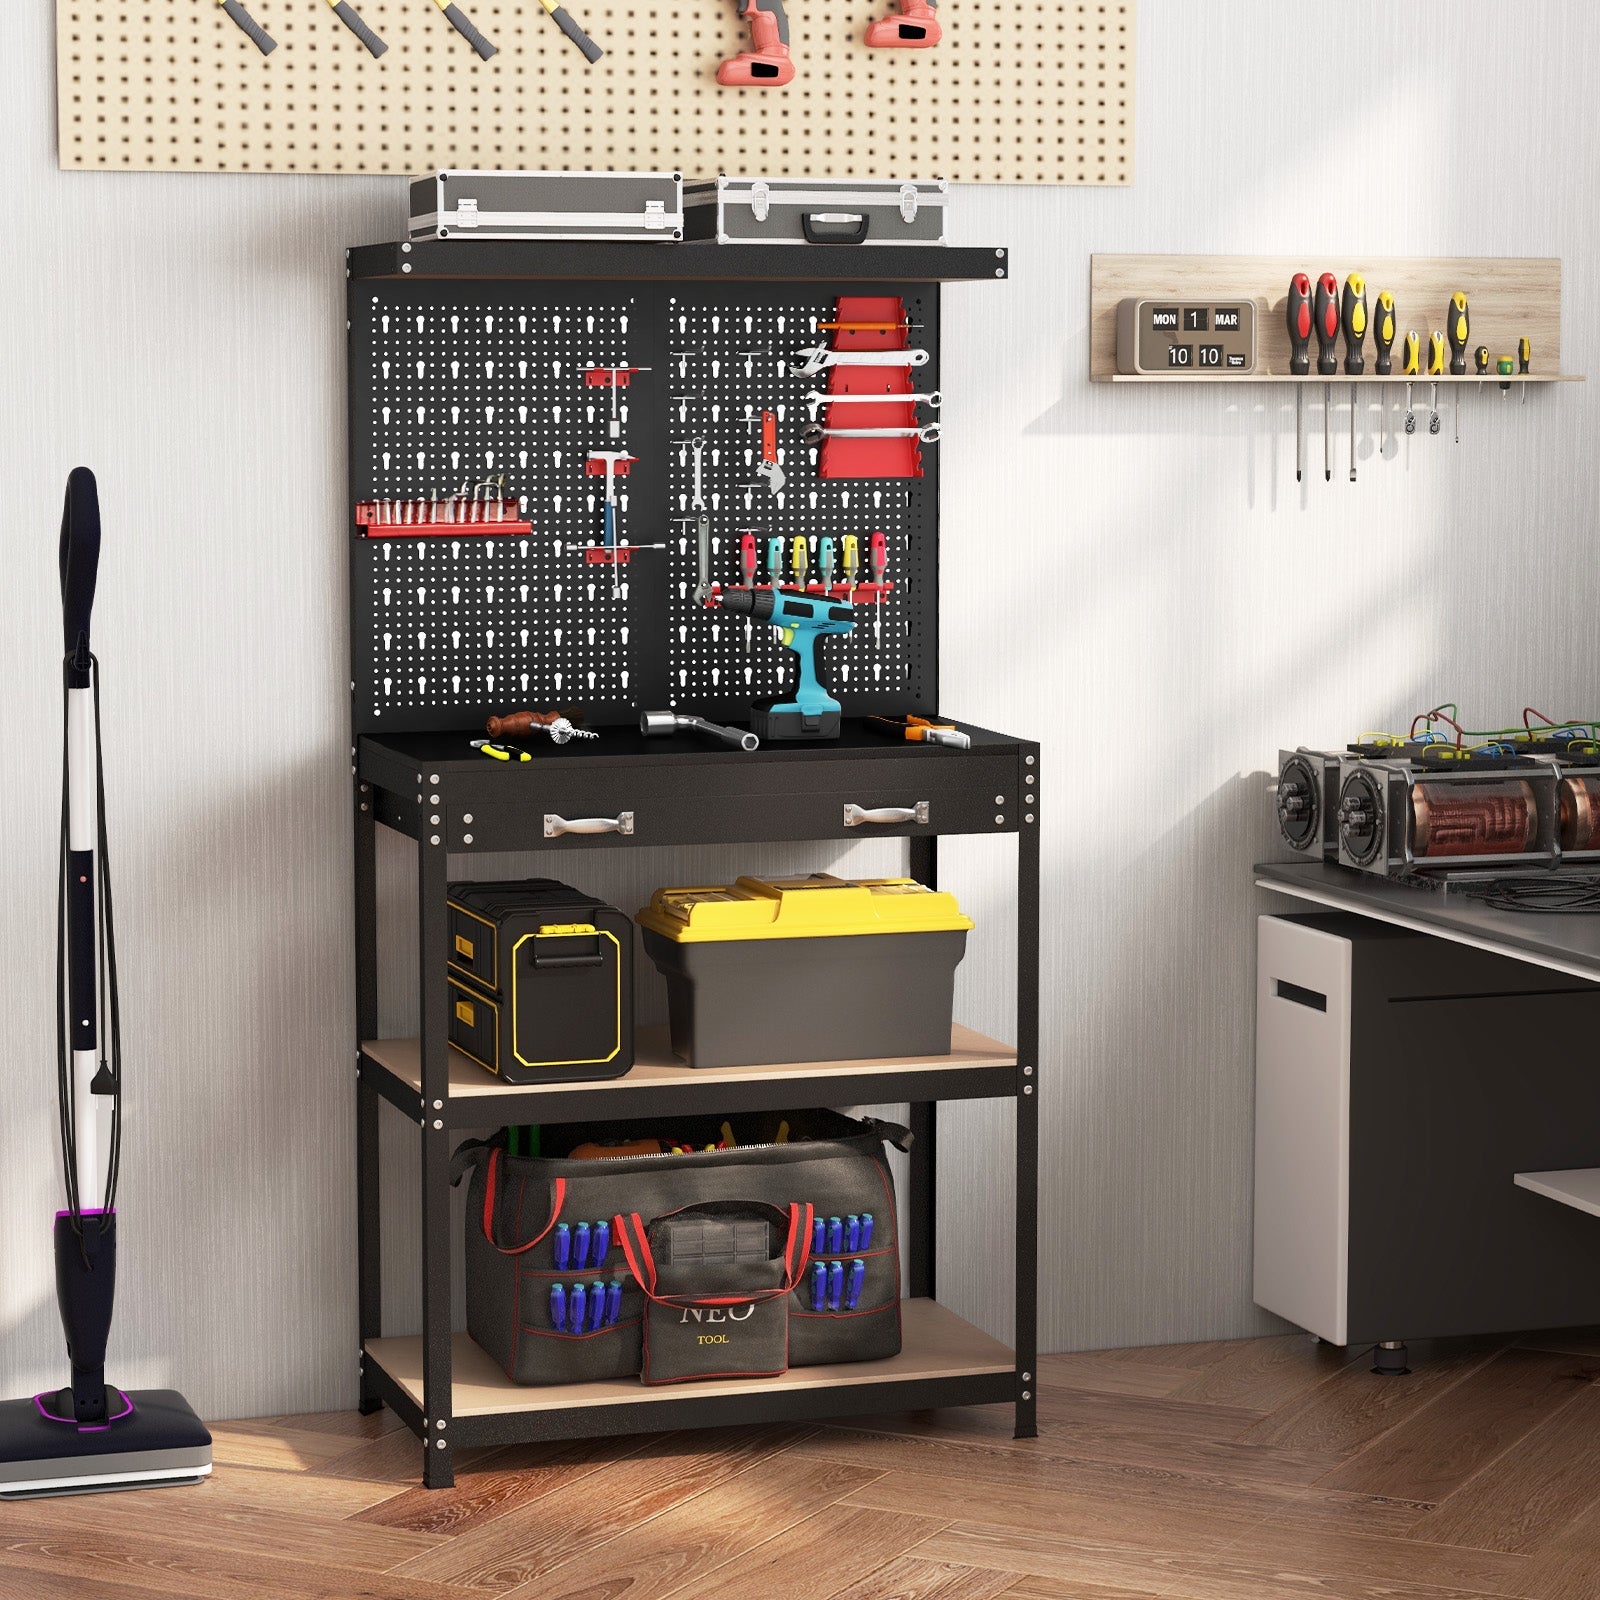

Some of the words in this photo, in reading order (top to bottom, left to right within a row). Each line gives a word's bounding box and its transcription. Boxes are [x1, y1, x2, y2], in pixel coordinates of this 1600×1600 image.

[1153, 314, 1176, 325] MON
[1190, 311, 1197, 328] 1
[1215, 314, 1238, 326] MAR
[1169, 348, 1188, 364] 10
[1200, 348, 1219, 364] 10
[697, 1334, 730, 1345] TOOL
